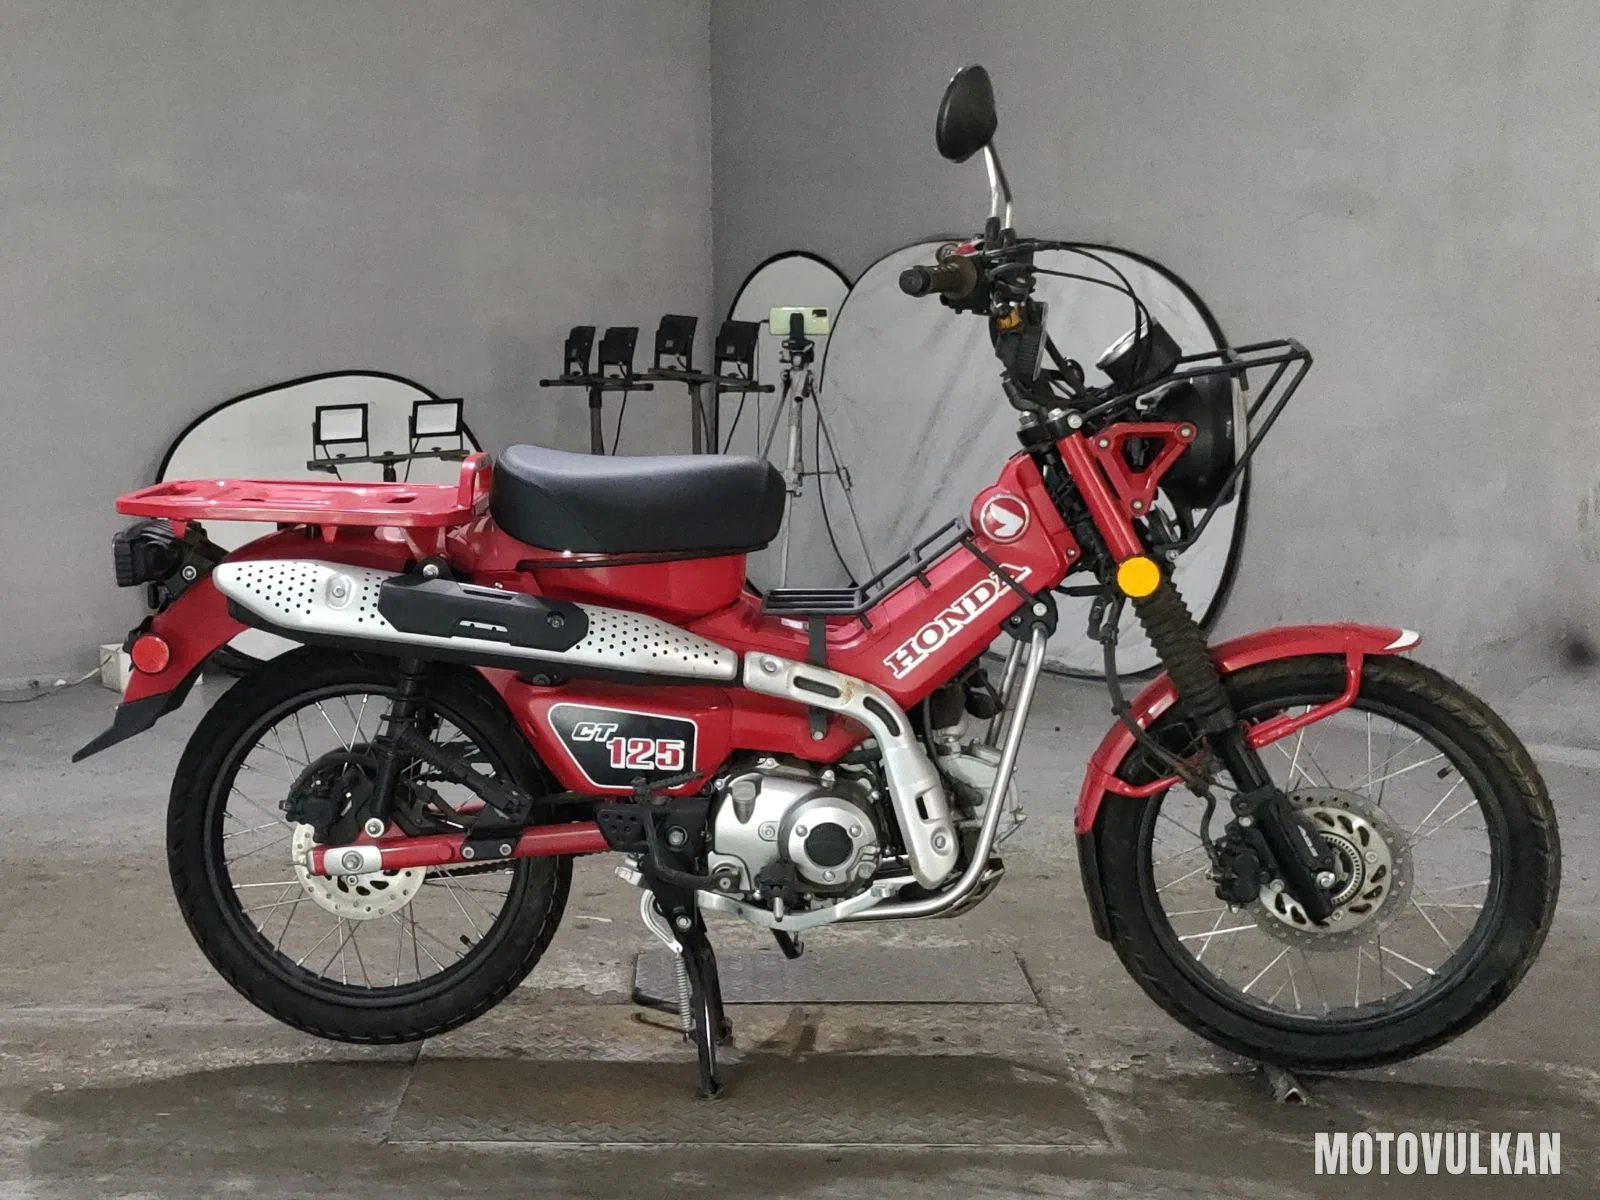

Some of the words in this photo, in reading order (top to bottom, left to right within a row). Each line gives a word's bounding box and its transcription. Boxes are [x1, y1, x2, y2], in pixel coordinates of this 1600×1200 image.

[883, 563, 1032, 680] HONDA
[572, 722, 618, 742] CT
[606, 737, 685, 770] 125
